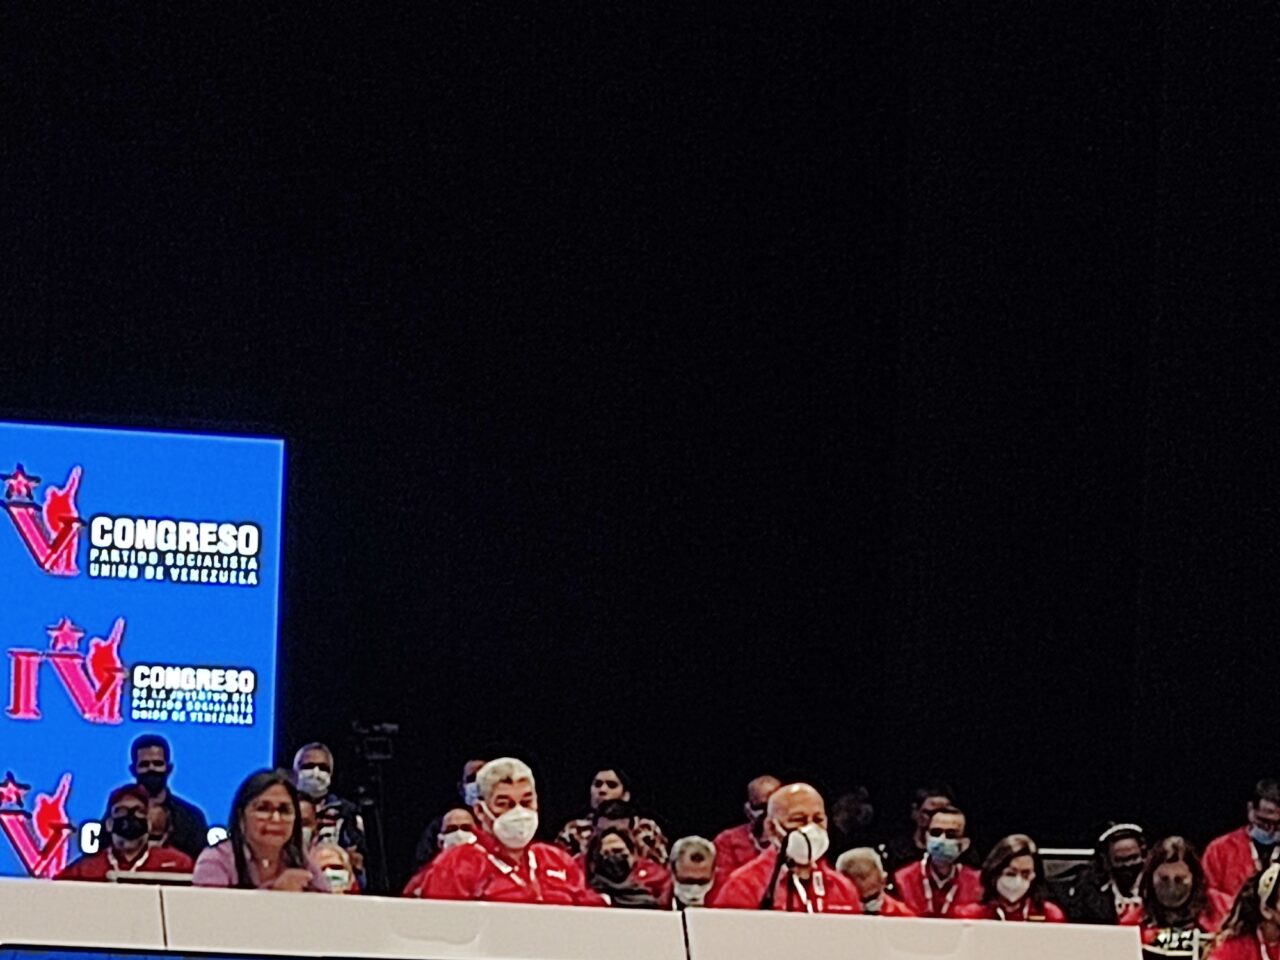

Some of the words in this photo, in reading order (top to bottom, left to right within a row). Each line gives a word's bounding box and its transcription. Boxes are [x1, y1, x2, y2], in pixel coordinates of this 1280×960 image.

[91, 516, 259, 556] CONGRESO
[90, 548, 158, 566] PARTIDO
[165, 551, 258, 570] SOCIALISTA
[89, 563, 139, 579] UNIDO
[144, 566, 164, 580] DE
[170, 567, 258, 585] VENEZUELA
[133, 665, 255, 693] CONGRESO
